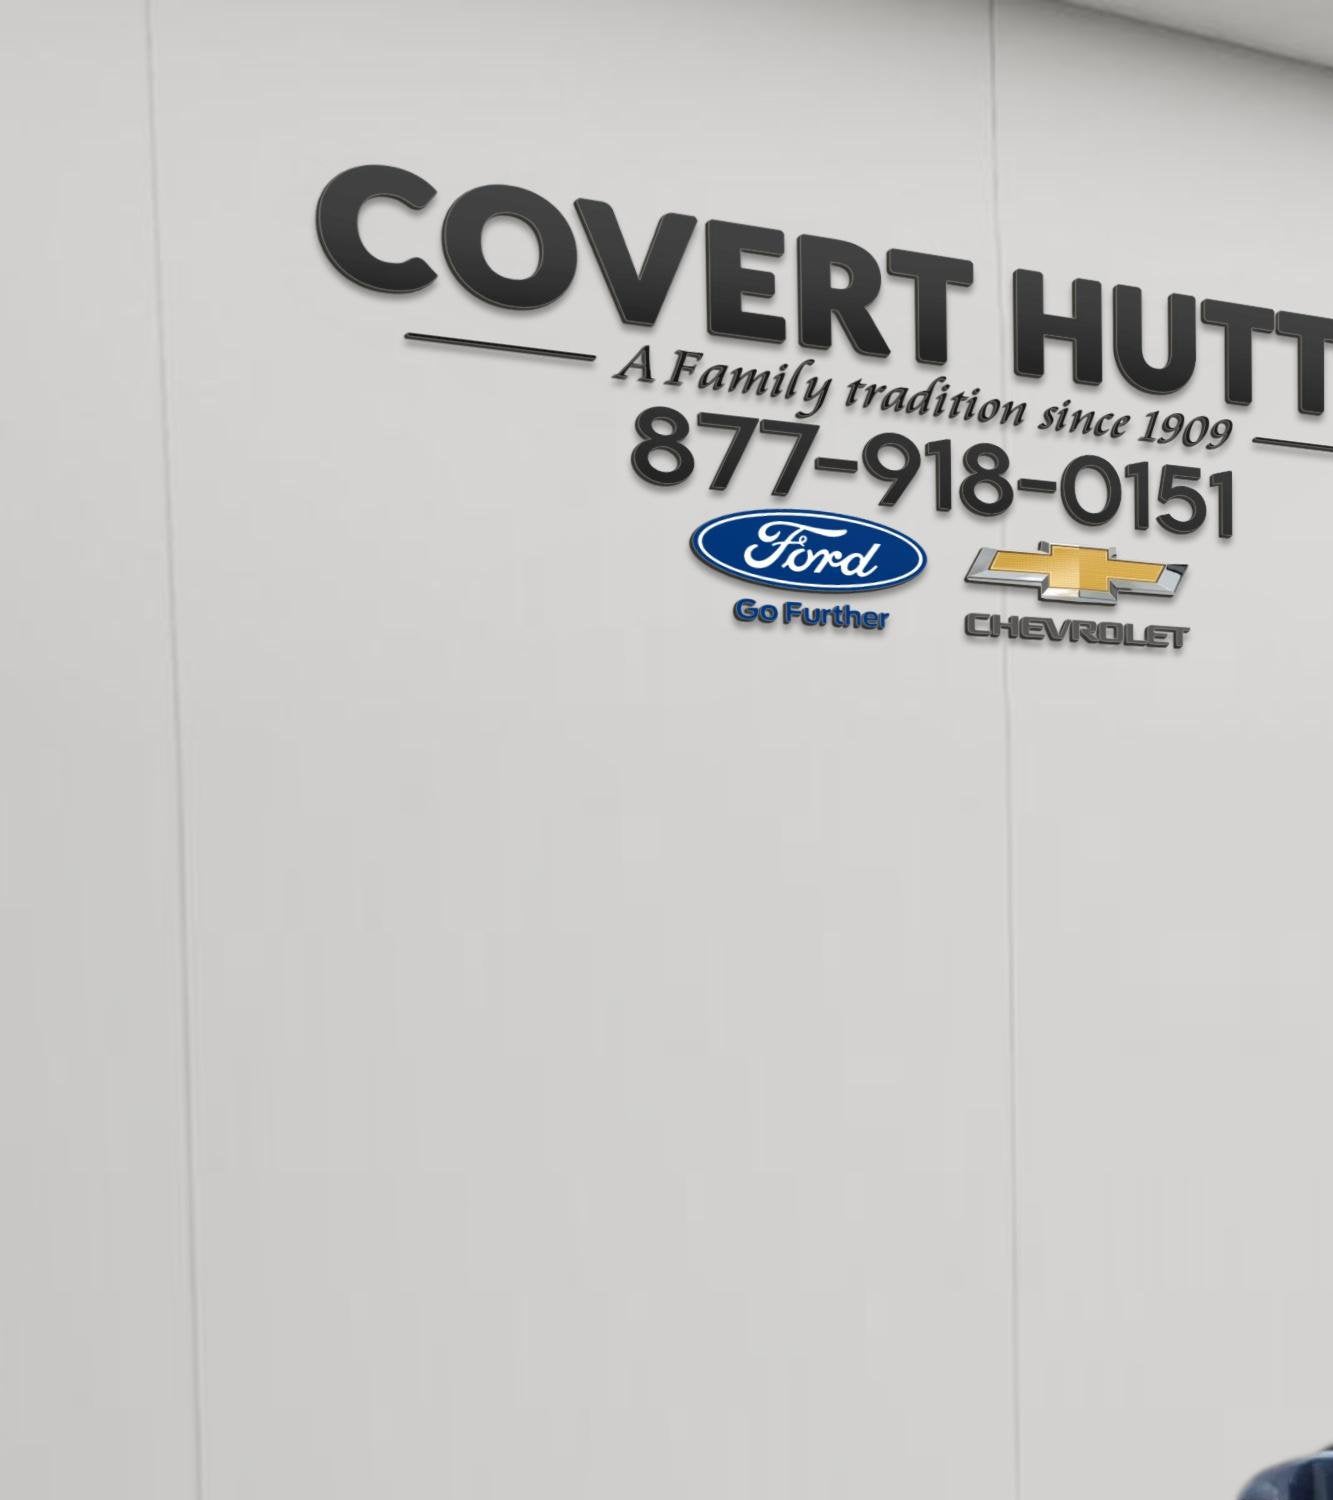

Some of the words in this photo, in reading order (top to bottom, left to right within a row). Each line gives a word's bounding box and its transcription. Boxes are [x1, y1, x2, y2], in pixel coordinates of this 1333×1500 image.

[315, 164, 974, 368] COVERT
[612, 344, 656, 384] A
[663, 349, 833, 420] Family
[845, 374, 1028, 428] tradition
[1037, 399, 1132, 439] since
[1138, 409, 1234, 450] 1909
[630, 406, 1234, 540] 877-918-0151
[742, 520, 882, 579] Ford
[733, 597, 778, 624] Go
[782, 601, 890, 631] Further
[965, 613, 1191, 649] CHEVROLET
